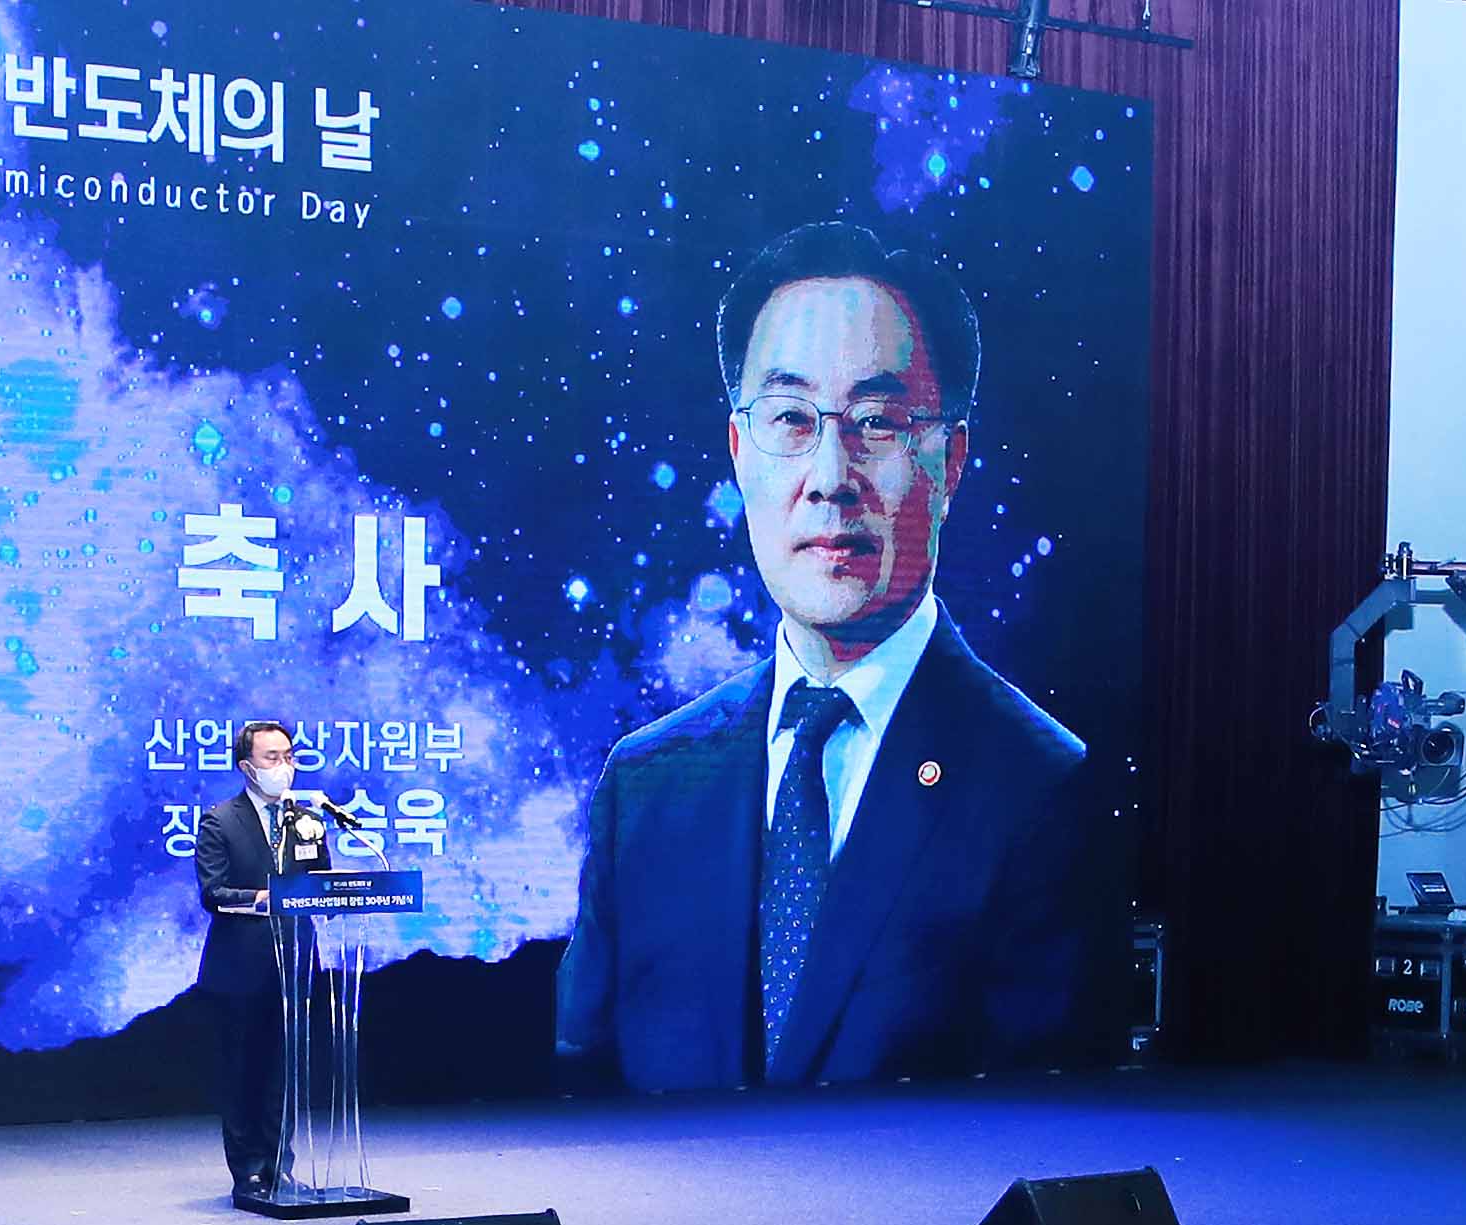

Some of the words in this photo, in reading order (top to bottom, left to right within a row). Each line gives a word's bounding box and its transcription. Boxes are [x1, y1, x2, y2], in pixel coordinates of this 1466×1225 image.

[4, 52, 285, 164] 반도체의
[314, 86, 381, 173] 날
[300, 190, 372, 230] Day
[144, 717, 465, 773] 산업상자원부
[1402, 958, 1413, 975] 2
